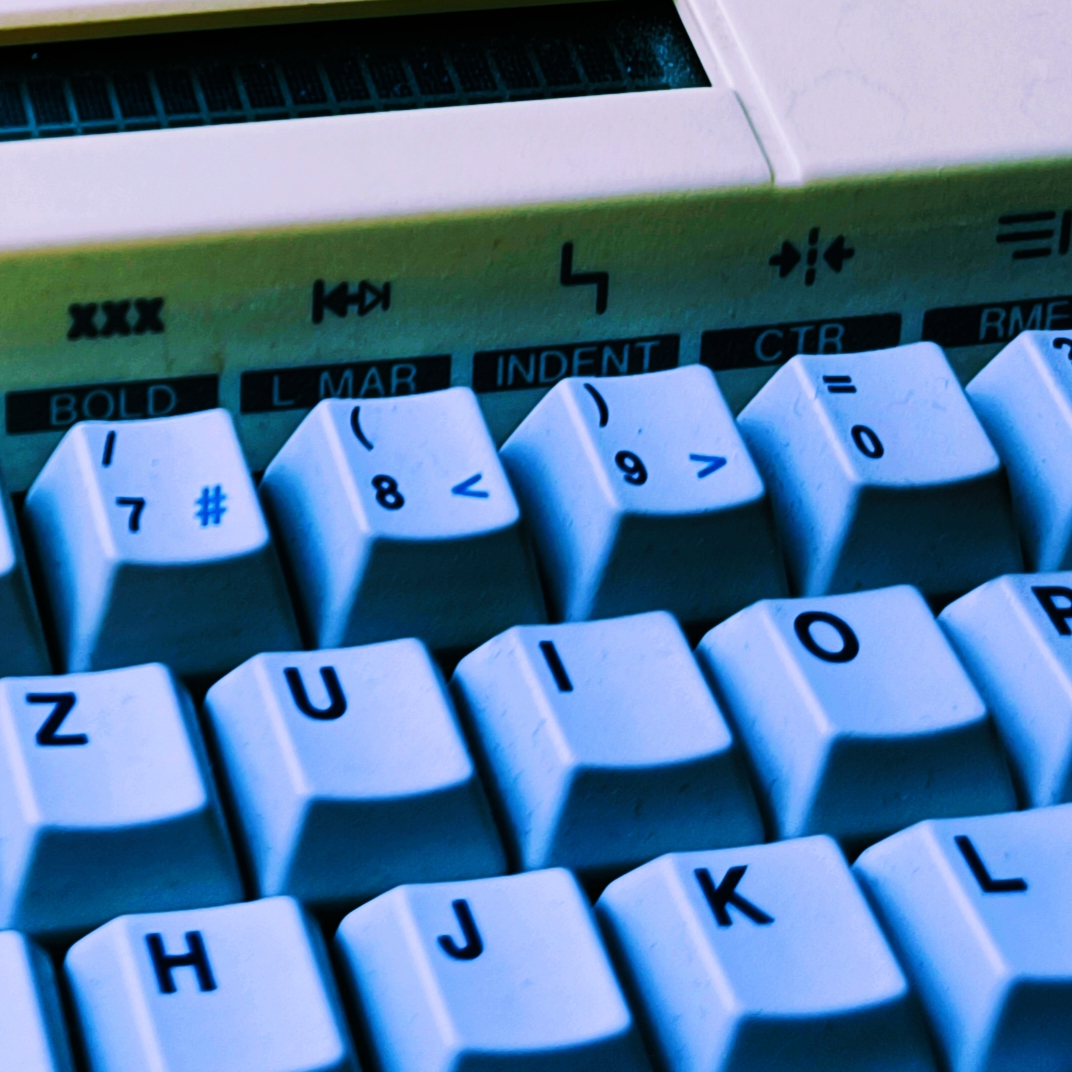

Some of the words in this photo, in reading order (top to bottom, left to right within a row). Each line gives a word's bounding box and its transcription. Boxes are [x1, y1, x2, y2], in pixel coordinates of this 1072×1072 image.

[496, 340, 661, 385] INDENT
[754, 322, 845, 362] CTR
[49, 384, 177, 426] BOLD
[272, 375, 295, 406] L
[318, 363, 418, 399] MAR
[582, 382, 610, 429] )
[821, 374, 858, 395] =
[349, 405, 375, 453] (
[450, 472, 490, 500] <
[613, 449, 649, 488] 9
[688, 452, 728, 480] >
[114, 495, 147, 535] 7
[194, 484, 228, 528] #
[370, 473, 406, 512] 8
[1030, 585, 1072, 638] P
[792, 610, 861, 665] O
[537, 639, 575, 695] I
[282, 665, 349, 723] U
[23, 691, 91, 749] Z
[952, 833, 1031, 897] L
[692, 864, 776, 931] K
[435, 898, 486, 963] J
[142, 929, 219, 997] H
